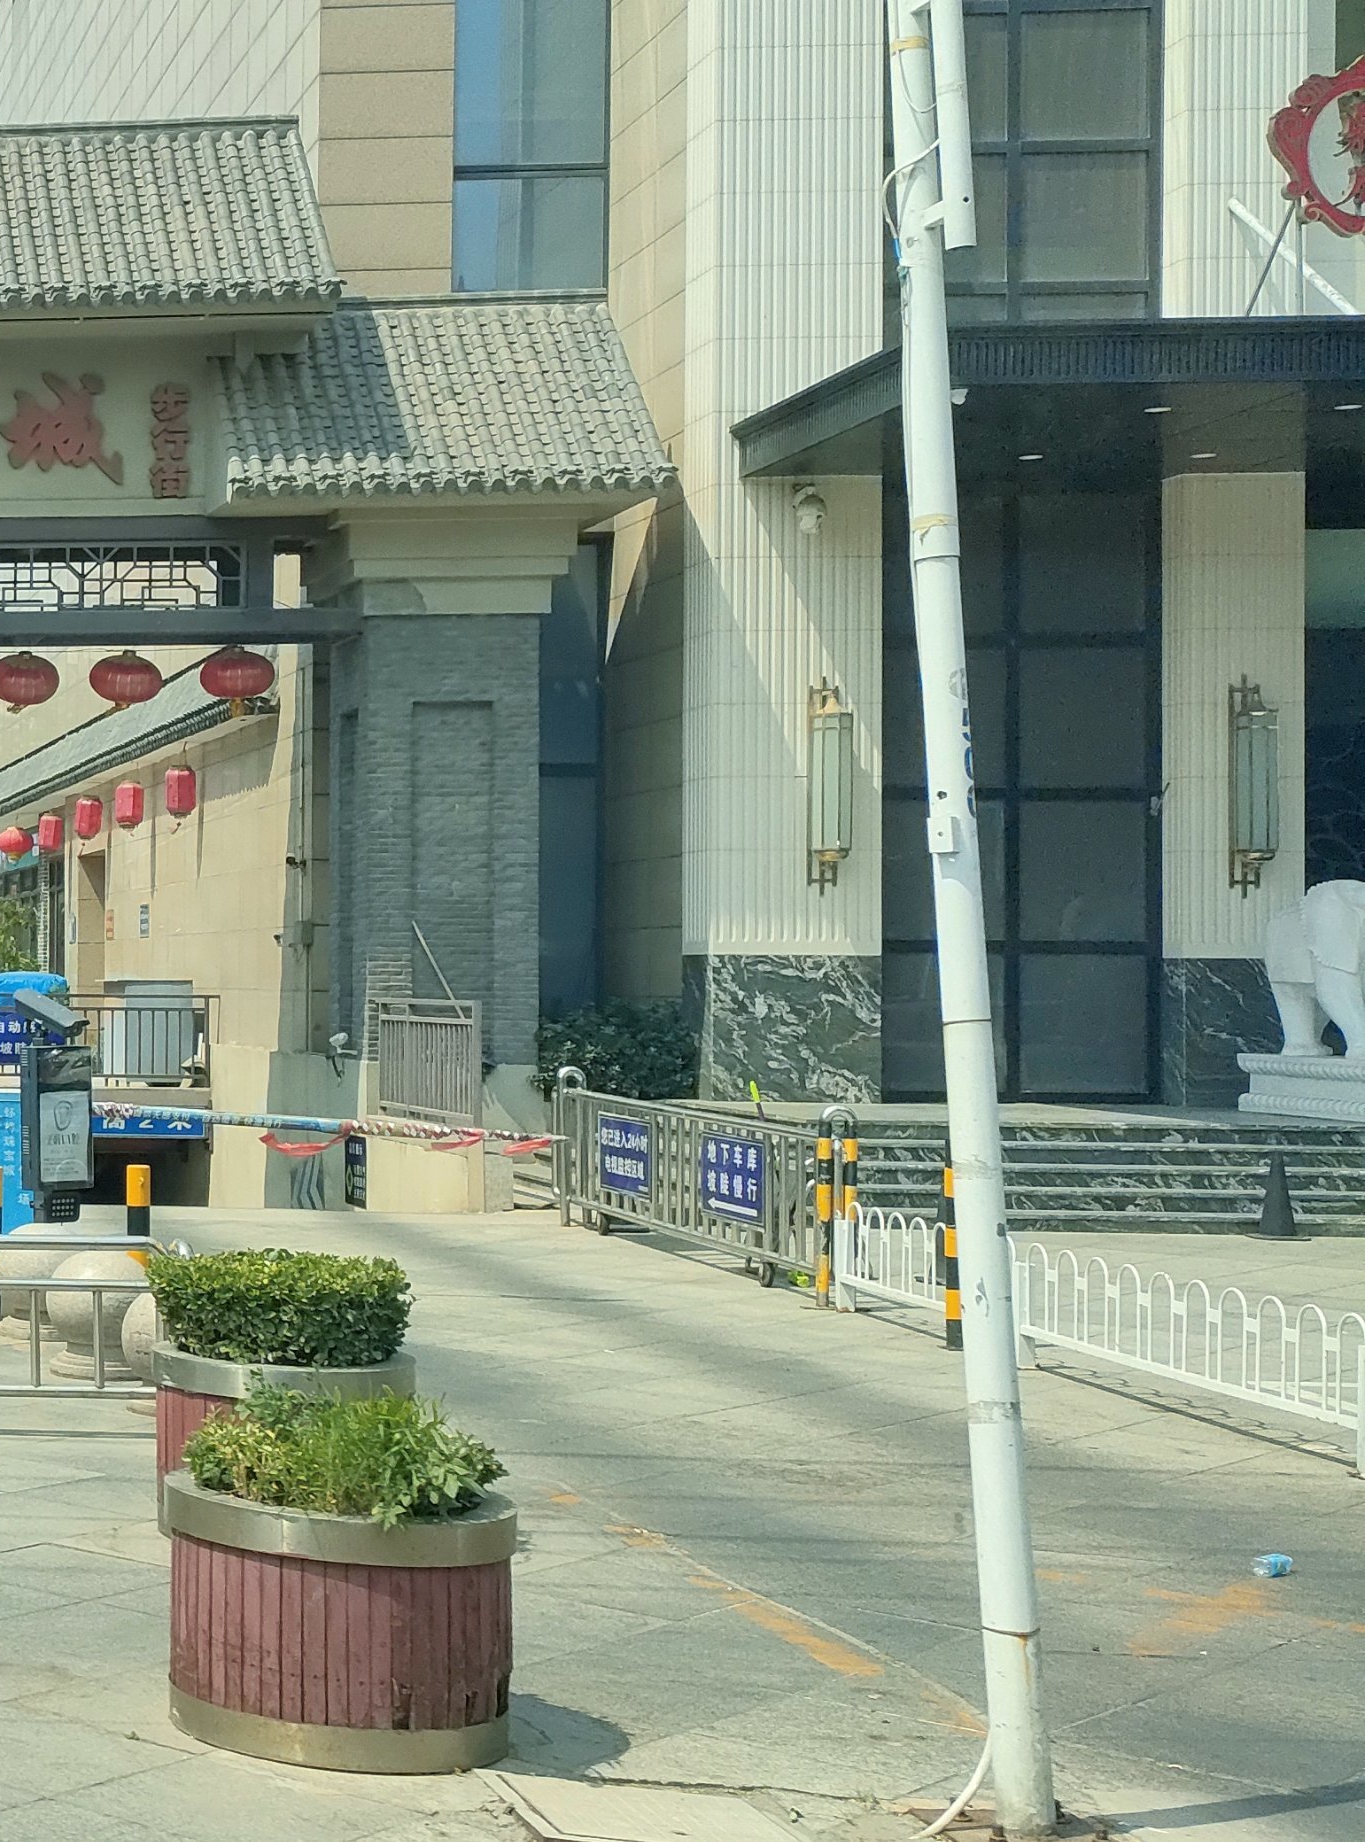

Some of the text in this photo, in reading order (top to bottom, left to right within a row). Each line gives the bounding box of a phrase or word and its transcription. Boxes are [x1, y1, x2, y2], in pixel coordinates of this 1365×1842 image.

[707, 1139, 757, 1171] 地下车库
[707, 1169, 757, 1202] 坡陡慢行
